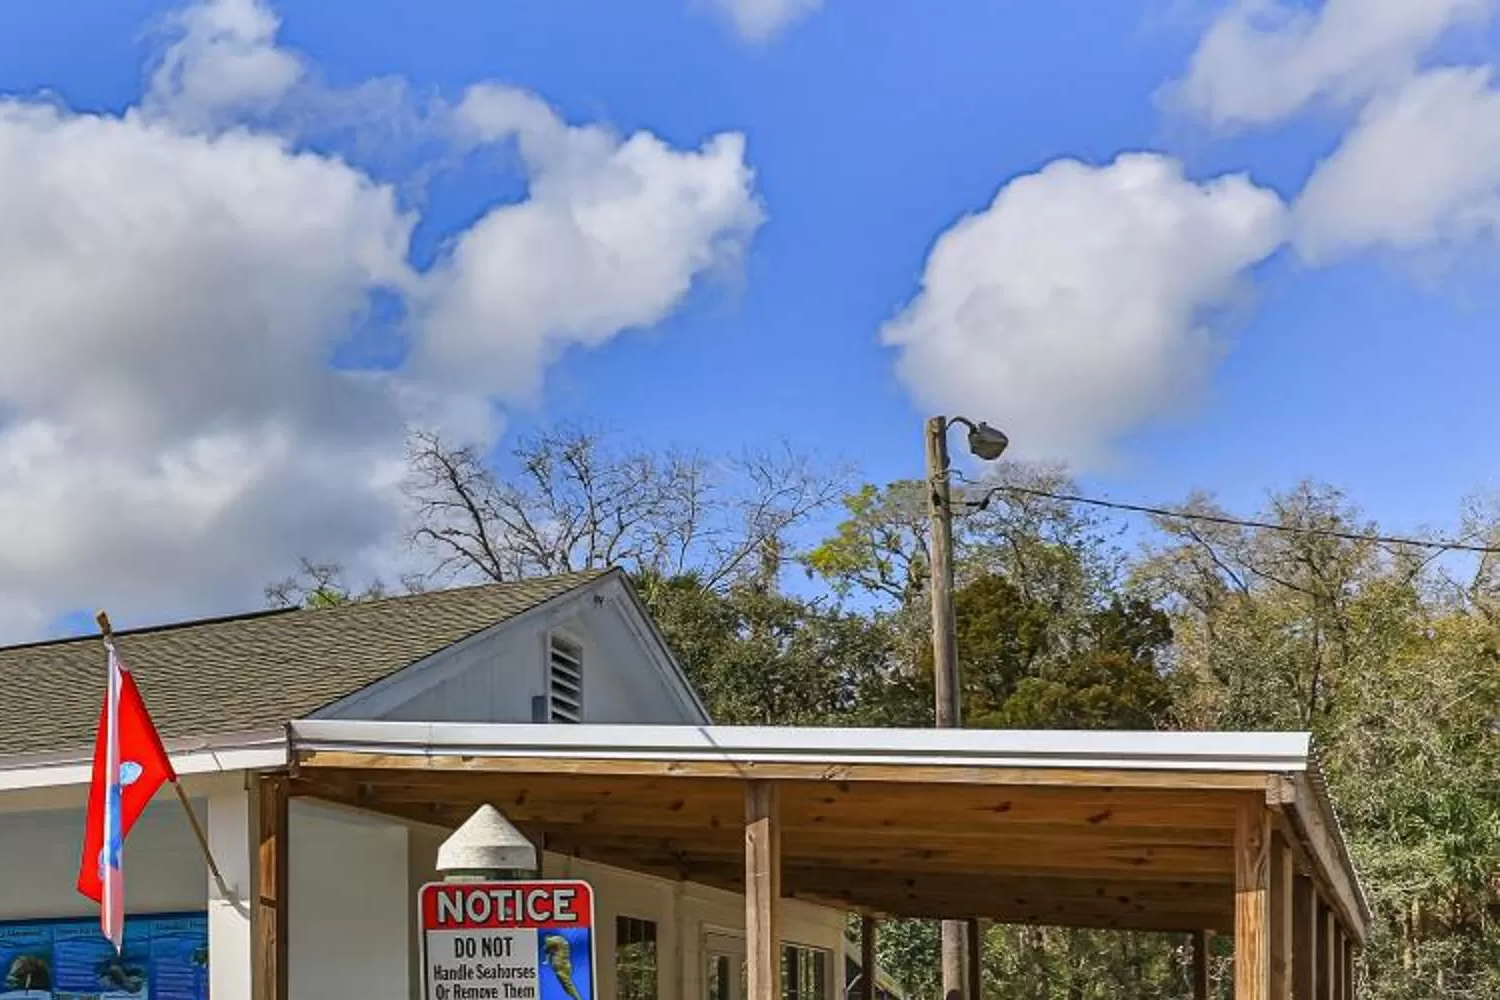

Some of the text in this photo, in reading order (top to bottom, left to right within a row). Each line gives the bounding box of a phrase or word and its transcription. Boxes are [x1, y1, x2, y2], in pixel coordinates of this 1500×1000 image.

[436, 889, 577, 923] NOTICE
[454, 936, 513, 958] DO NOT
[433, 963, 536, 981] Handle Seahorses
[436, 983, 535, 1000] Or Remove Them
